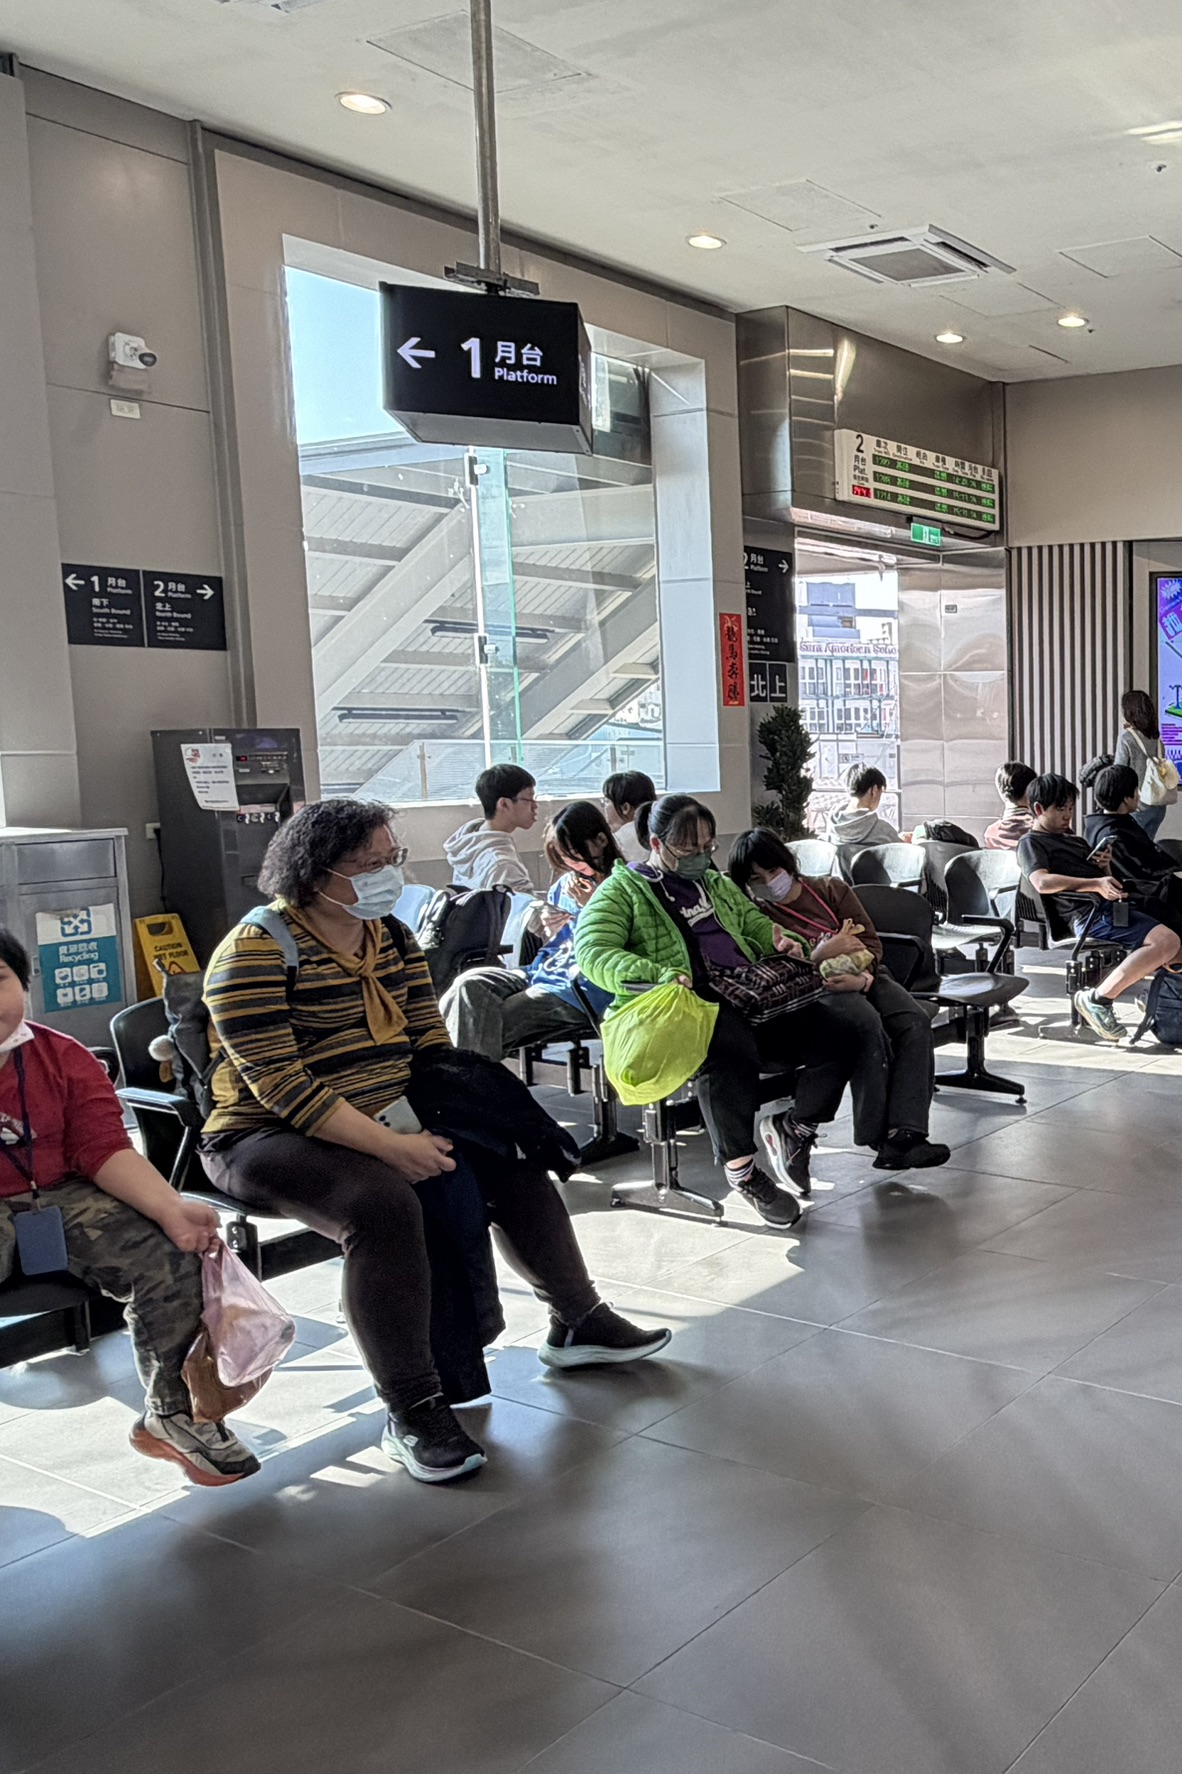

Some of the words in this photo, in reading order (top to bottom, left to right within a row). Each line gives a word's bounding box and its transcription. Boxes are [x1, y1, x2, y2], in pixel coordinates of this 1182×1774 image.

[460, 337, 482, 379] 1
[495, 341, 544, 367] 月台
[494, 367, 558, 385] Platform
[856, 433, 865, 454] 2
[854, 454, 867, 466] 月台
[90, 575, 99, 592] 1
[107, 576, 127, 588] 月台
[153, 580, 165, 597] 2
[167, 581, 186, 592] 月台
[750, 673, 786, 697] 北上
[59, 951, 99, 963] Recycling
